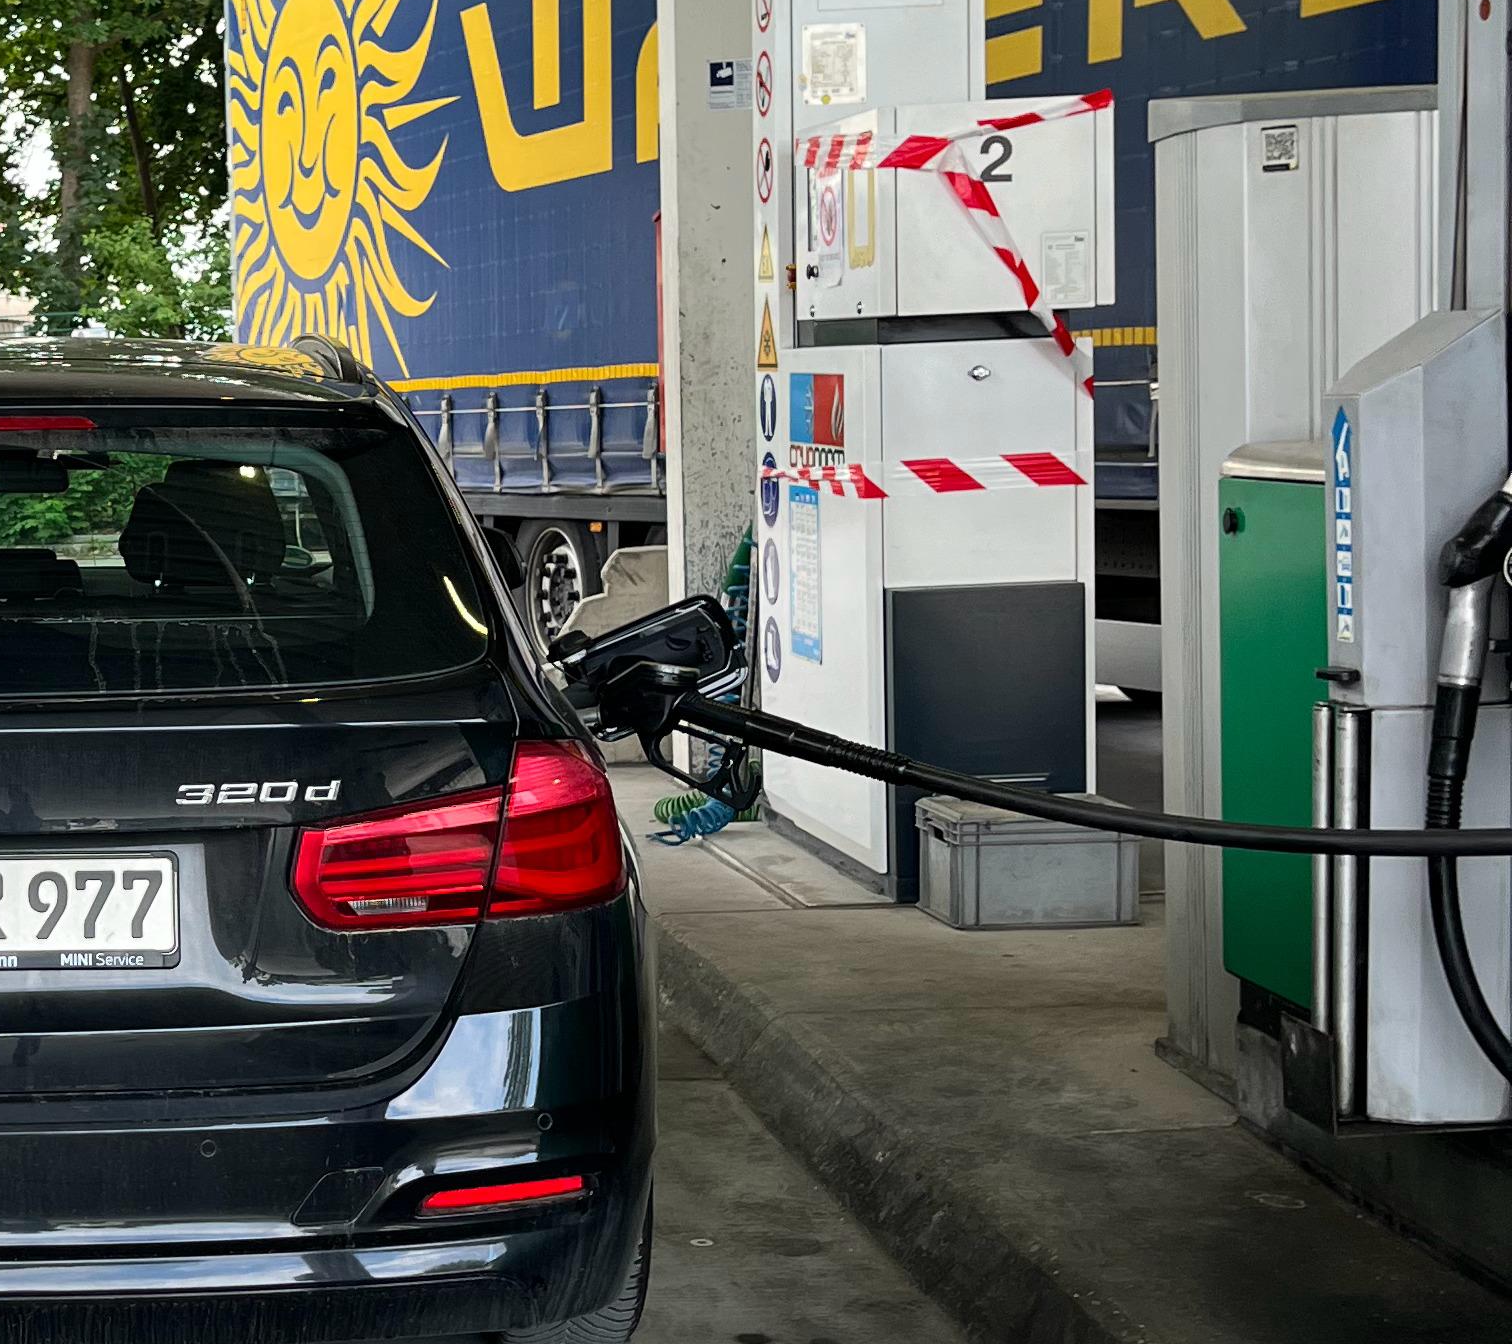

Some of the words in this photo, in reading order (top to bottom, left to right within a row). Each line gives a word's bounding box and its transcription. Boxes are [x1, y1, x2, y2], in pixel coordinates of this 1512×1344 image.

[980, 135, 1013, 182] 2
[175, 779, 341, 805] 320d
[28, 870, 163, 940] 977
[60, 952, 94, 967] MINI
[95, 952, 144, 967] Service
